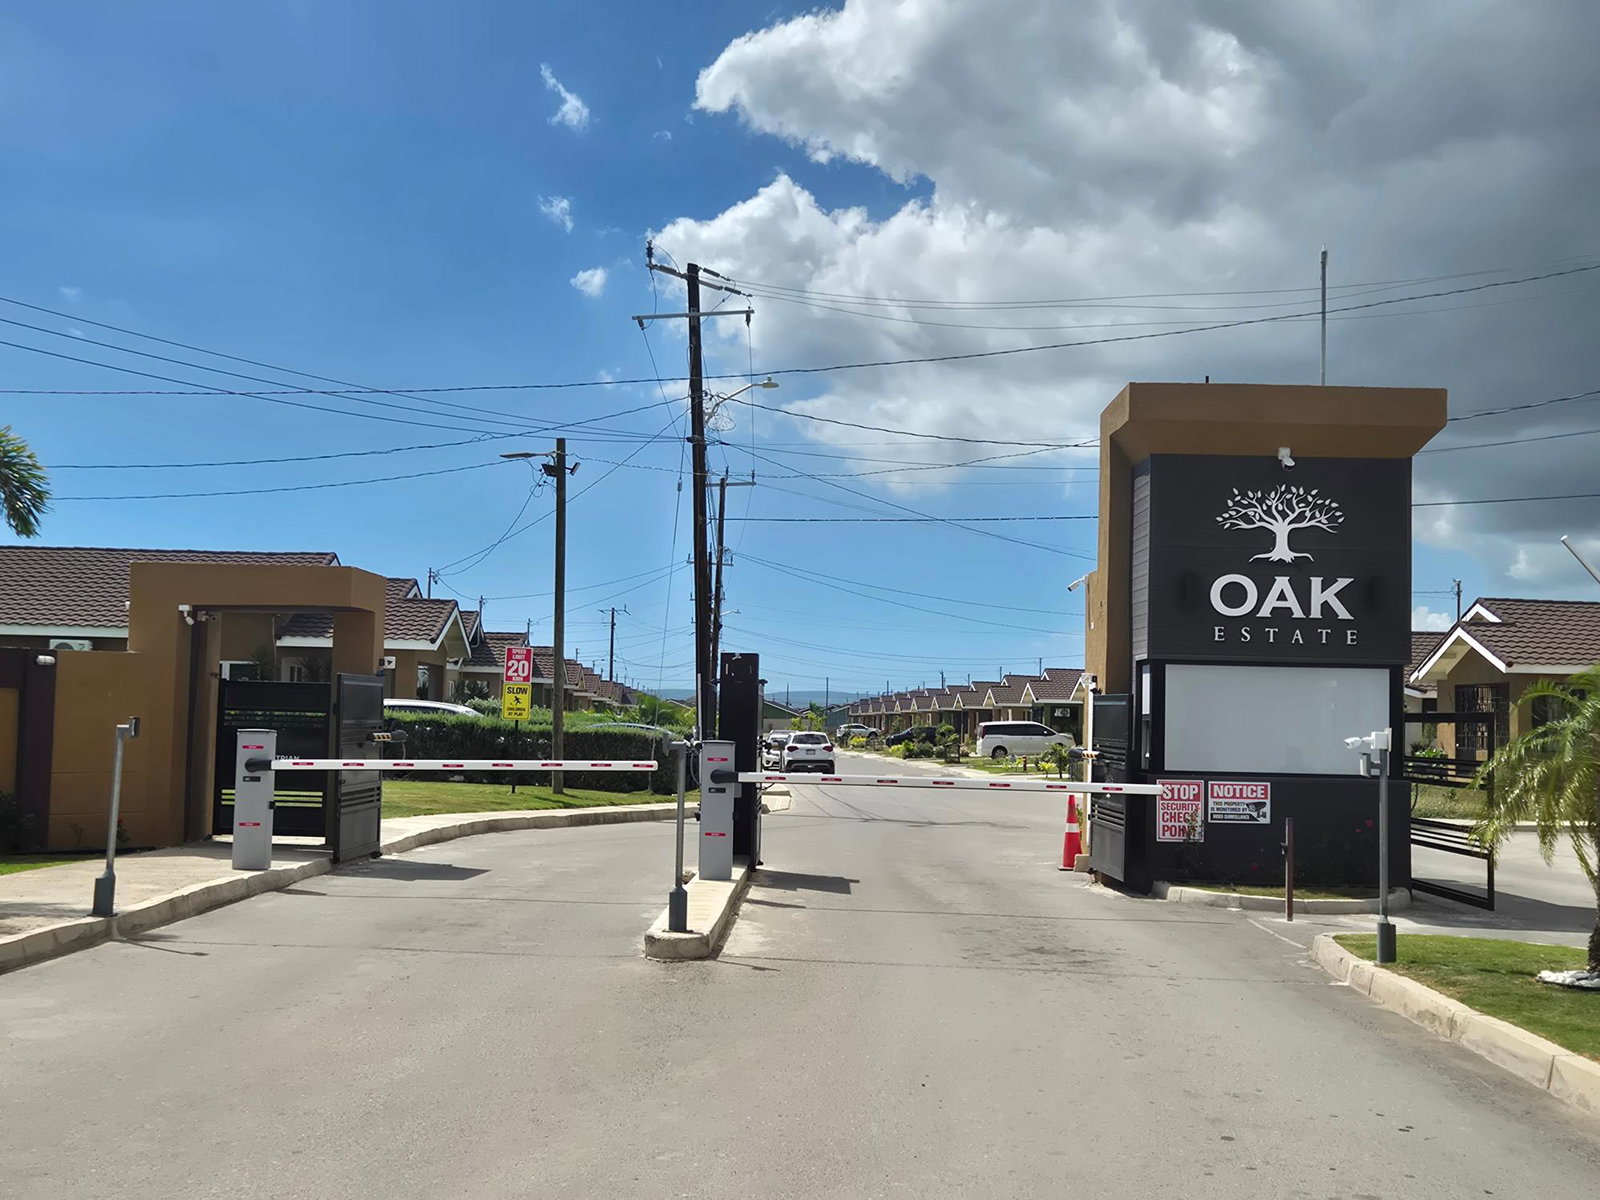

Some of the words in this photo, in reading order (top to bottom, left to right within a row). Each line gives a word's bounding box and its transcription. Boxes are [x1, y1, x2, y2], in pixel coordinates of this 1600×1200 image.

[1210, 573, 1355, 620] OAK
[1214, 626, 1358, 645] ESTATE
[507, 660, 529, 677] 20
[1162, 784, 1199, 799] STOP
[1213, 785, 1265, 798] NOTICE
[1161, 802, 1199, 811] SECURITY
